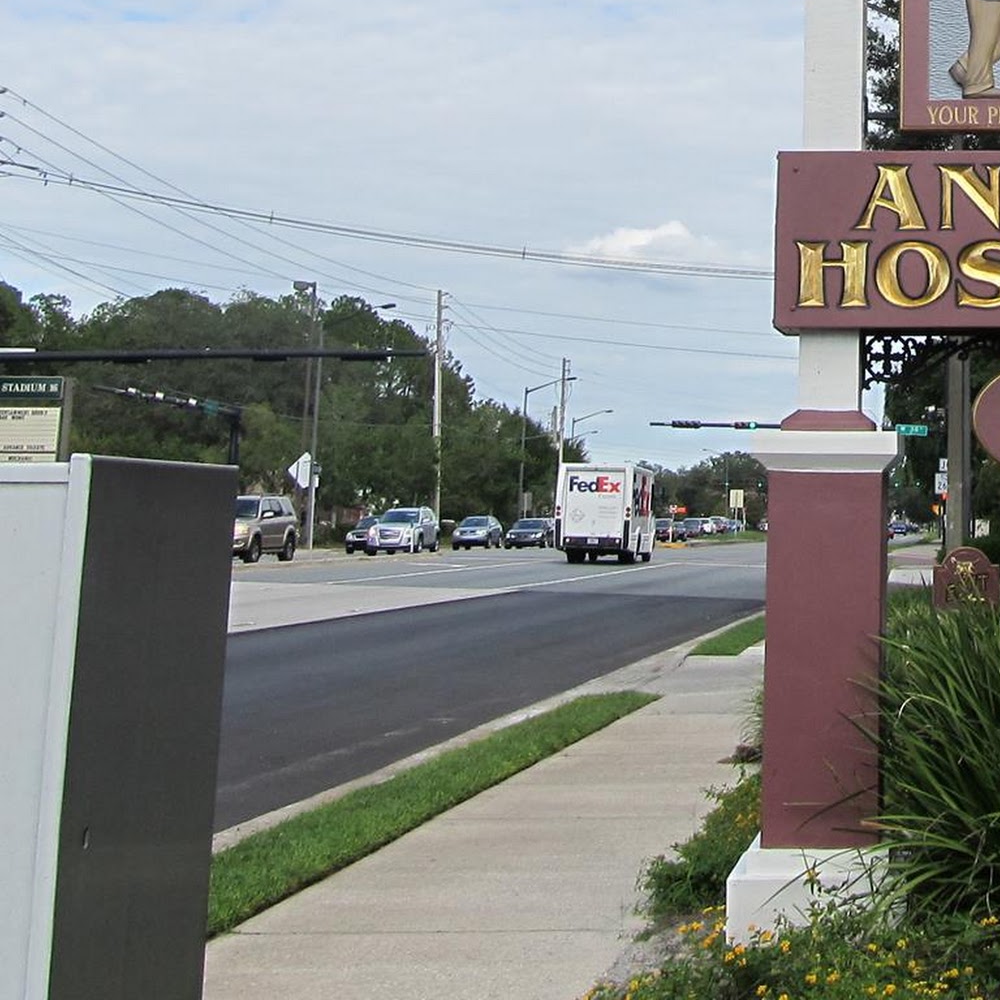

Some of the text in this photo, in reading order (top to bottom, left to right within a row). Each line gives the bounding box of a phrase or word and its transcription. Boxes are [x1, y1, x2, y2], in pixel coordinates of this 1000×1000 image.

[927, 104, 978, 124] YOUR
[1, 383, 46, 393] STADIUM
[569, 476, 621, 493] FedEx
